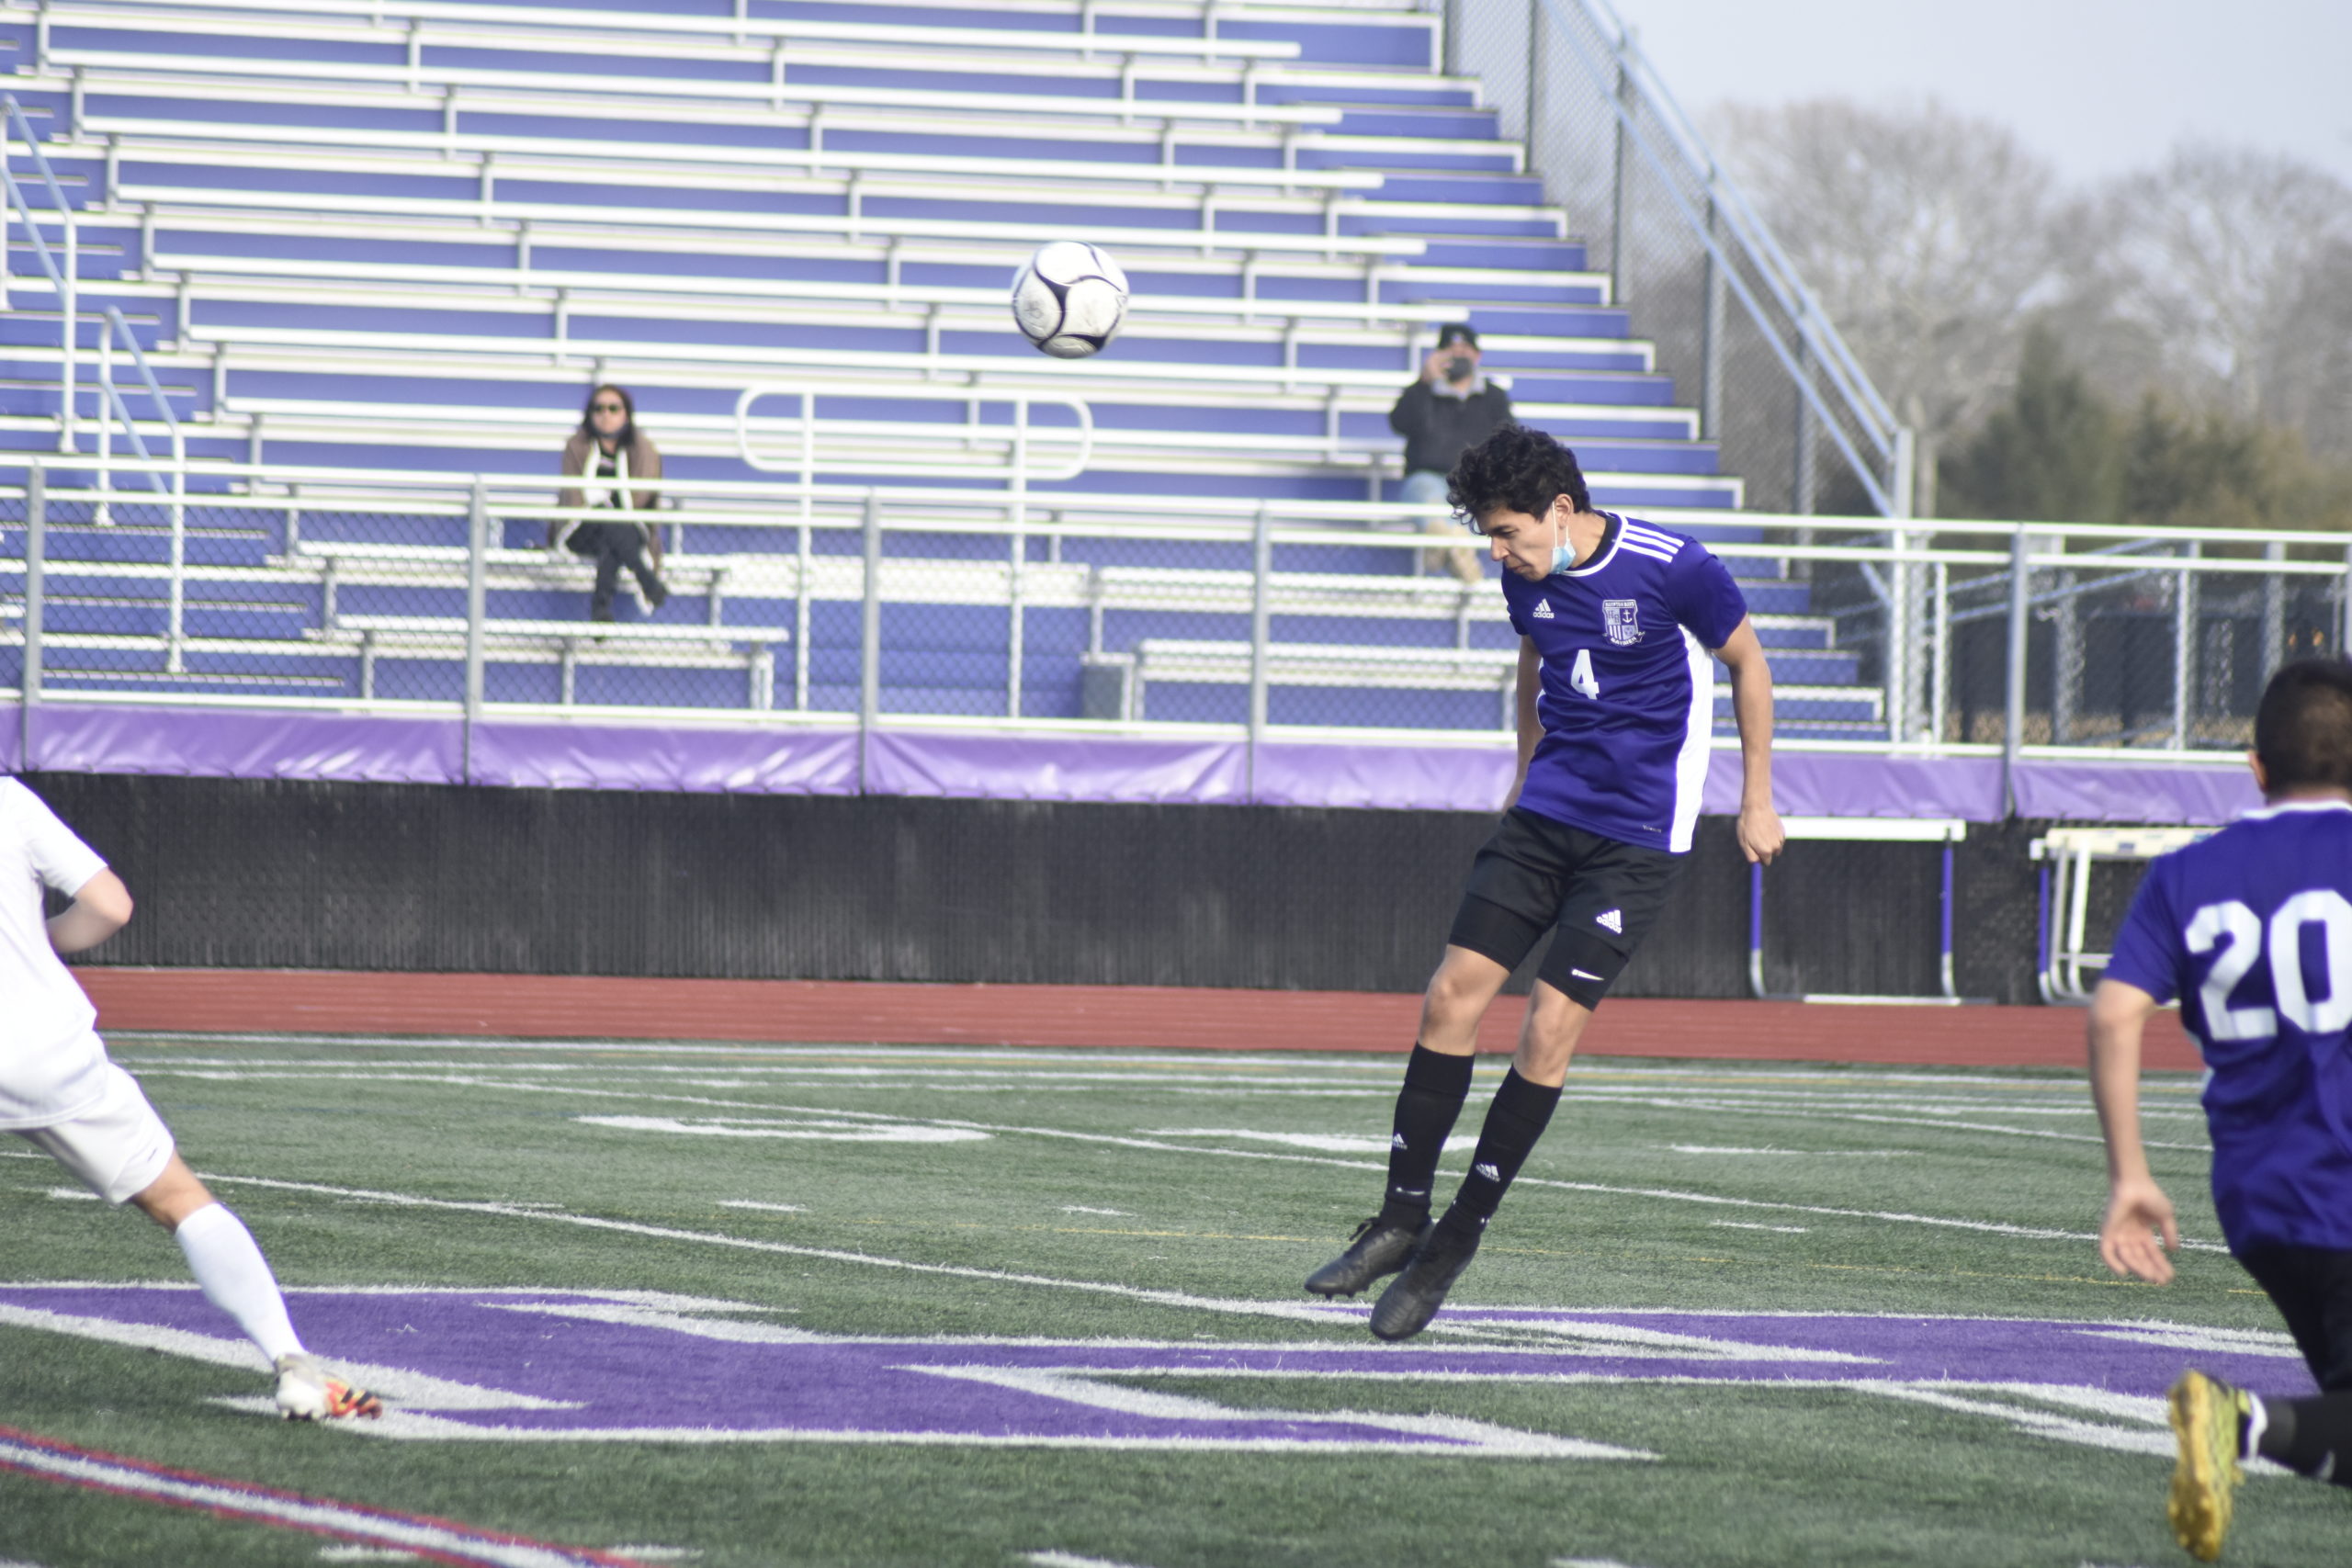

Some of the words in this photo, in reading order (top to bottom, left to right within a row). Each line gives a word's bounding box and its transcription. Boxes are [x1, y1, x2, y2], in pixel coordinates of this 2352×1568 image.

[1532, 610, 1555, 619] adidas
[1570, 649, 1600, 700] 4
[1597, 916, 1623, 934] adidas
[2185, 889, 2352, 1041] 20
